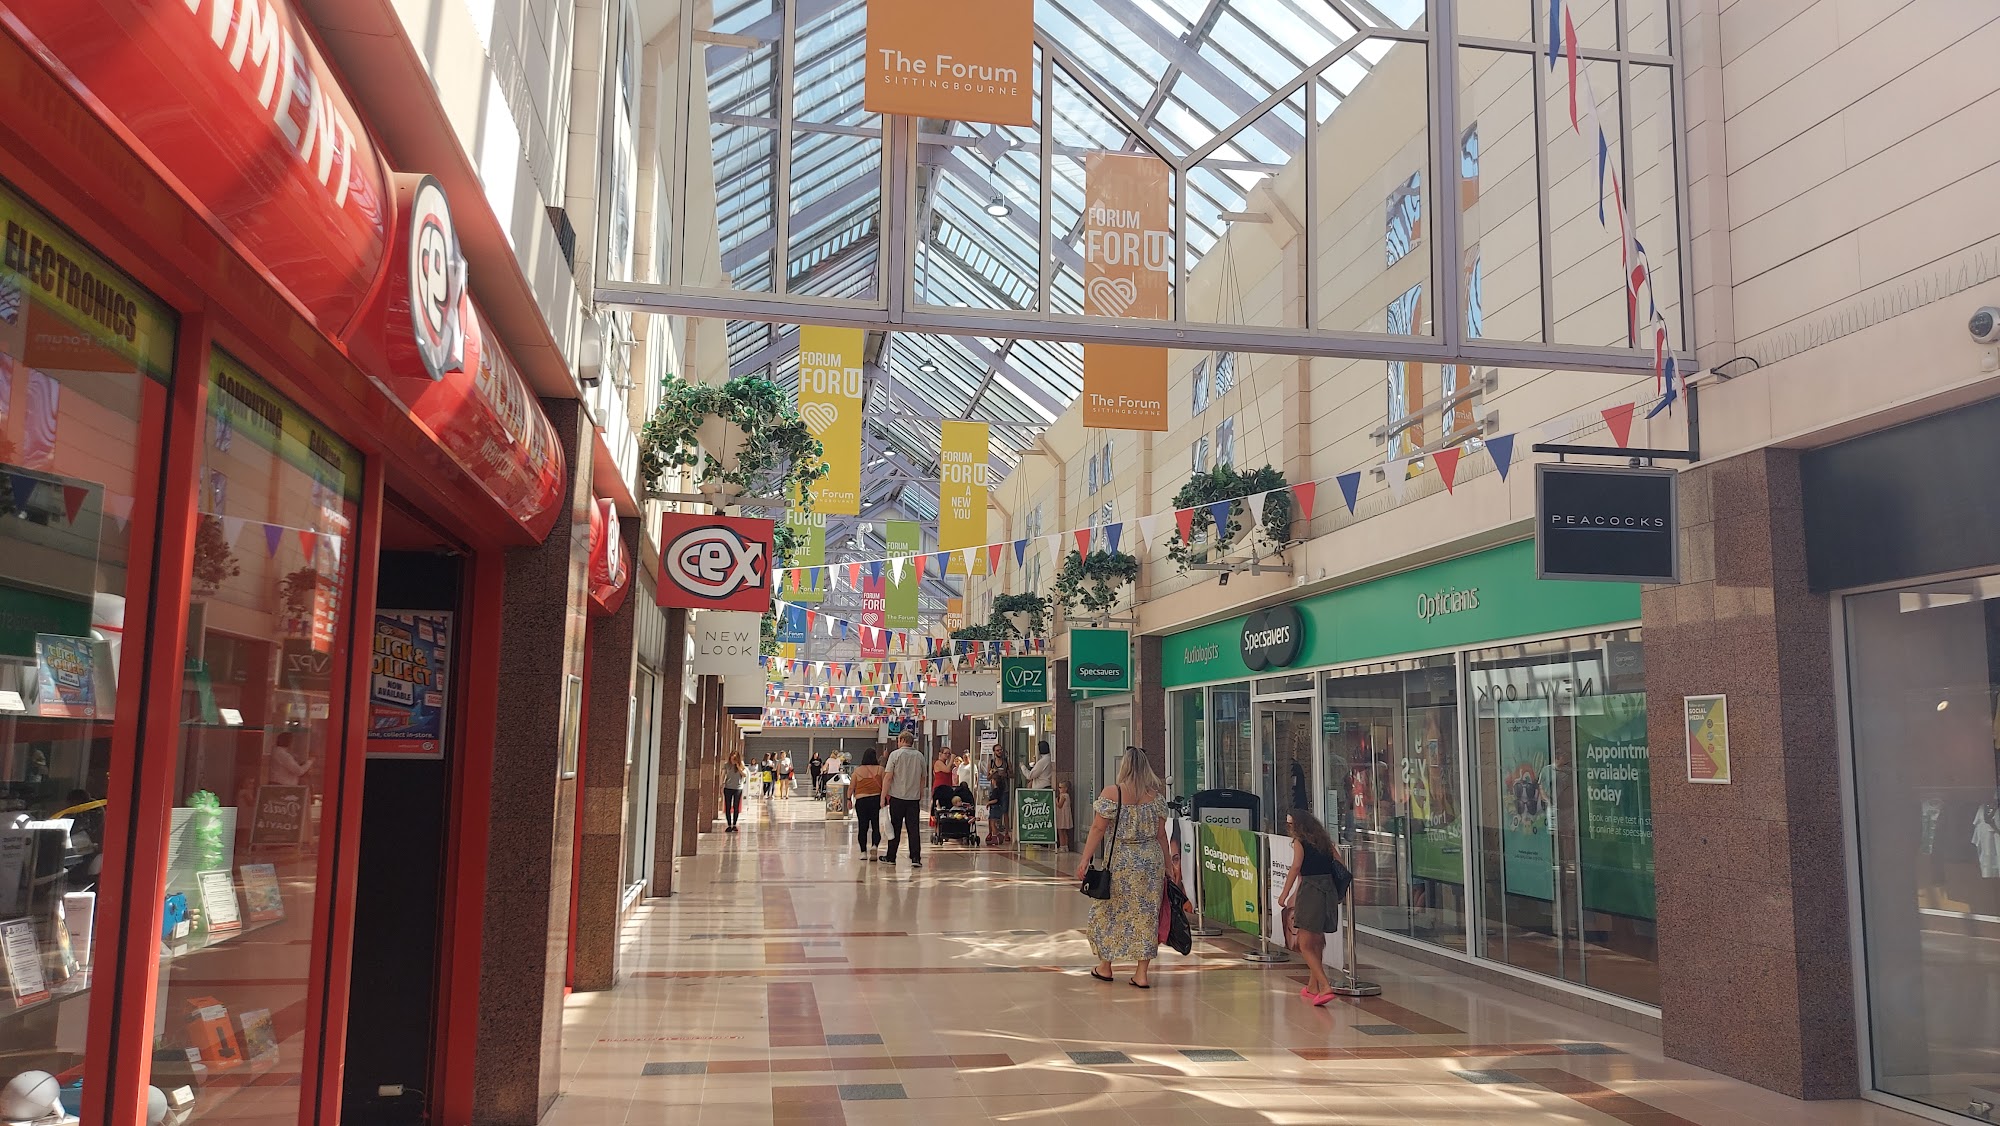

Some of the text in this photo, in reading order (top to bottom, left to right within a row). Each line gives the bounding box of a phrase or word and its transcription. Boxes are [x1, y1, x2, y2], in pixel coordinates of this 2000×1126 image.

[879, 48, 1018, 84] The Forum
[884, 74, 1018, 96] SITTINGBOURNE
[1088, 206, 1140, 229] FORUM
[4, 219, 138, 342] ELECTRONICS
[801, 351, 841, 368] FORUM
[1090, 394, 1160, 409] The Forum
[1092, 407, 1160, 416] SITTINGBOURNE
[942, 450, 972, 463] FORUM
[822, 488, 854, 499] Forum
[965, 485, 971, 496] A
[951, 496, 971, 508] NEW
[952, 508, 971, 520] YOU
[1551, 514, 1665, 527] PEACOCKS
[886, 542, 908, 550] FORUM
[1417, 586, 1480, 624] Opticians
[705, 631, 749, 642] NEW
[1244, 625, 1290, 655] Specsavers
[374, 633, 414, 662] LICK
[700, 644, 752, 656] LOOK
[1183, 642, 1219, 665] Audiologists
[372, 654, 432, 686] OLLECT
[1079, 666, 1121, 677] Specsavers
[1010, 670, 1042, 686] VPZ
[387, 680, 402, 690] NOW
[378, 687, 412, 701] AVAILABLE
[960, 689, 993, 698] abilityplus
[383, 730, 405, 739] collect
[1586, 763, 1639, 781] available
[1587, 785, 1621, 805] today
[1021, 803, 1050, 818] Deals
[1205, 815, 1235, 824] Good
[1588, 812, 1603, 822] Book
[1613, 816, 1624, 825] eye
[1624, 816, 1637, 825] test
[1027, 821, 1047, 830] DAY!
[1596, 825, 1614, 834] online
